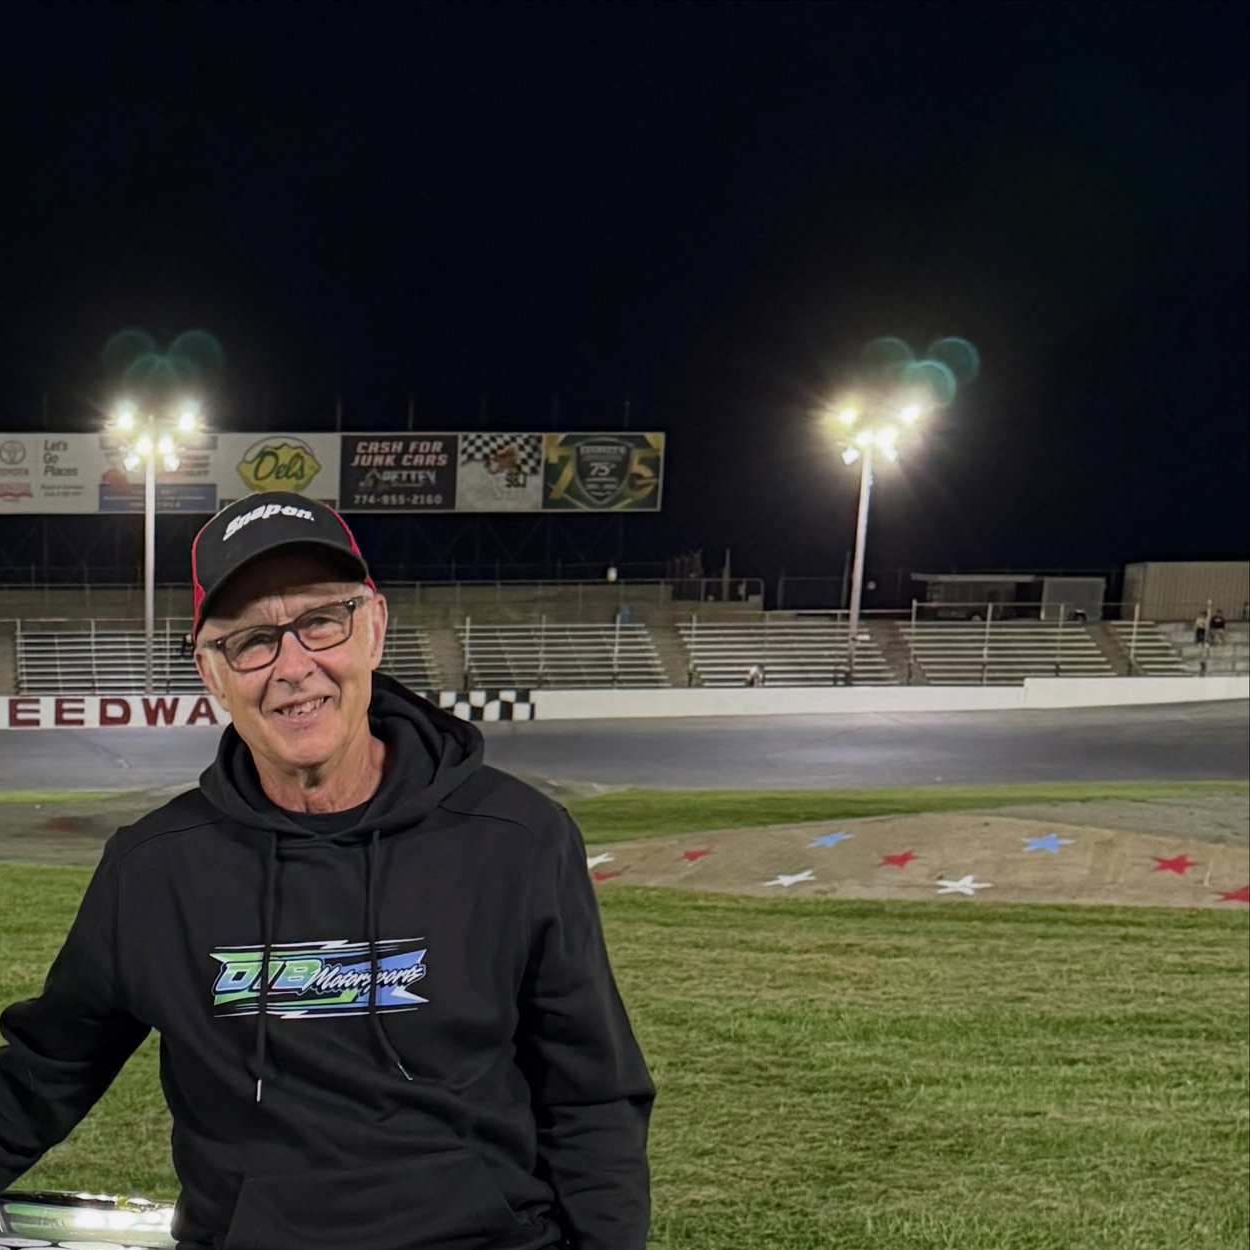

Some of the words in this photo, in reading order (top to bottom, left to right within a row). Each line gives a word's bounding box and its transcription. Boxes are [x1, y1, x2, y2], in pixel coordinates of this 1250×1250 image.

[43, 440, 69, 452] Let's
[356, 441, 403, 454] CASH
[407, 441, 444, 454] FOR
[42, 453, 59, 465] Go
[349, 453, 396, 467] JUNK
[401, 453, 449, 467] CARS
[43, 466, 79, 477] Places
